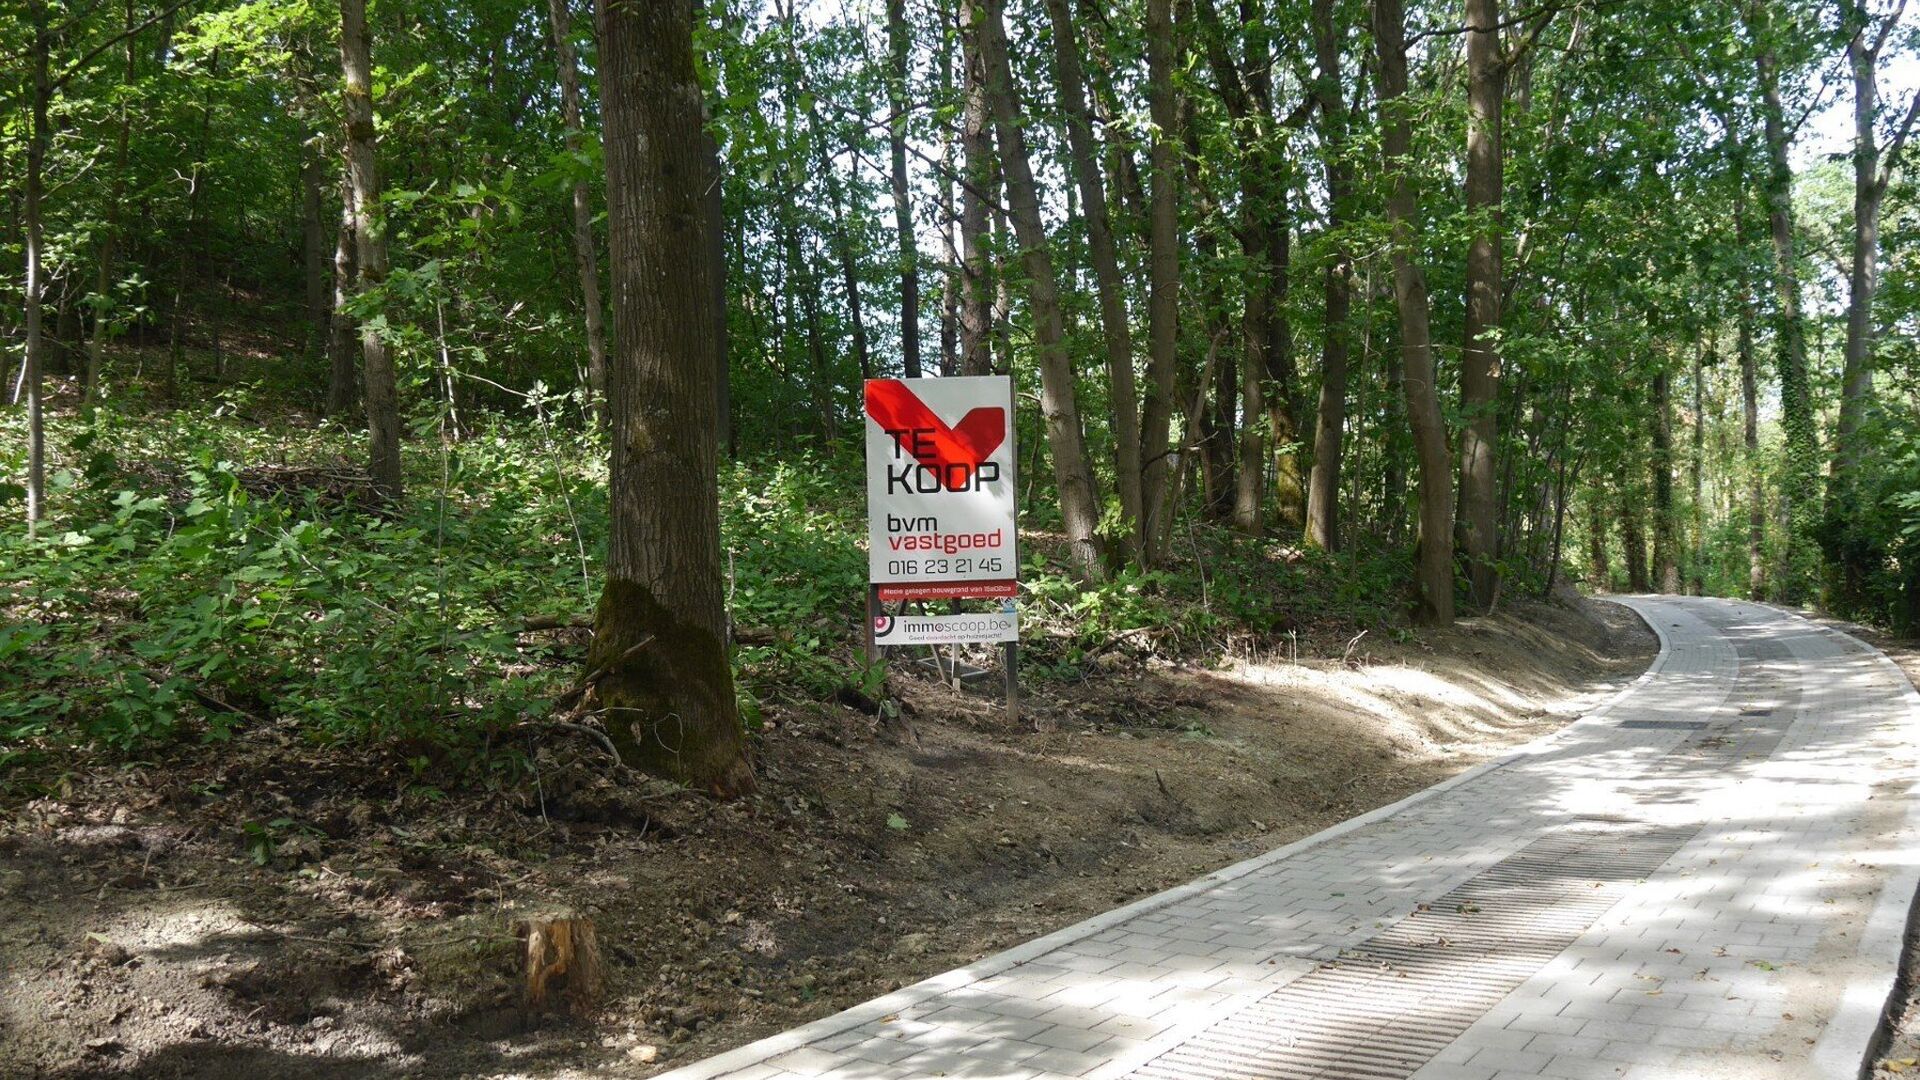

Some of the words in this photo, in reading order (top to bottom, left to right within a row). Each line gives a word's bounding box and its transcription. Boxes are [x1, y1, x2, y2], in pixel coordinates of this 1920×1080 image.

[885, 428, 936, 460] TE
[887, 461, 1000, 495] KOOP
[888, 513, 938, 532] bvm
[888, 529, 1001, 554] vastgoed
[888, 560, 918, 575] 016
[924, 559, 949, 574] 23
[956, 558, 973, 573] 21
[978, 557, 1002, 573] 45
[932, 586, 969, 595] bouwgrond
[904, 619, 1008, 634] immoscoop.be
